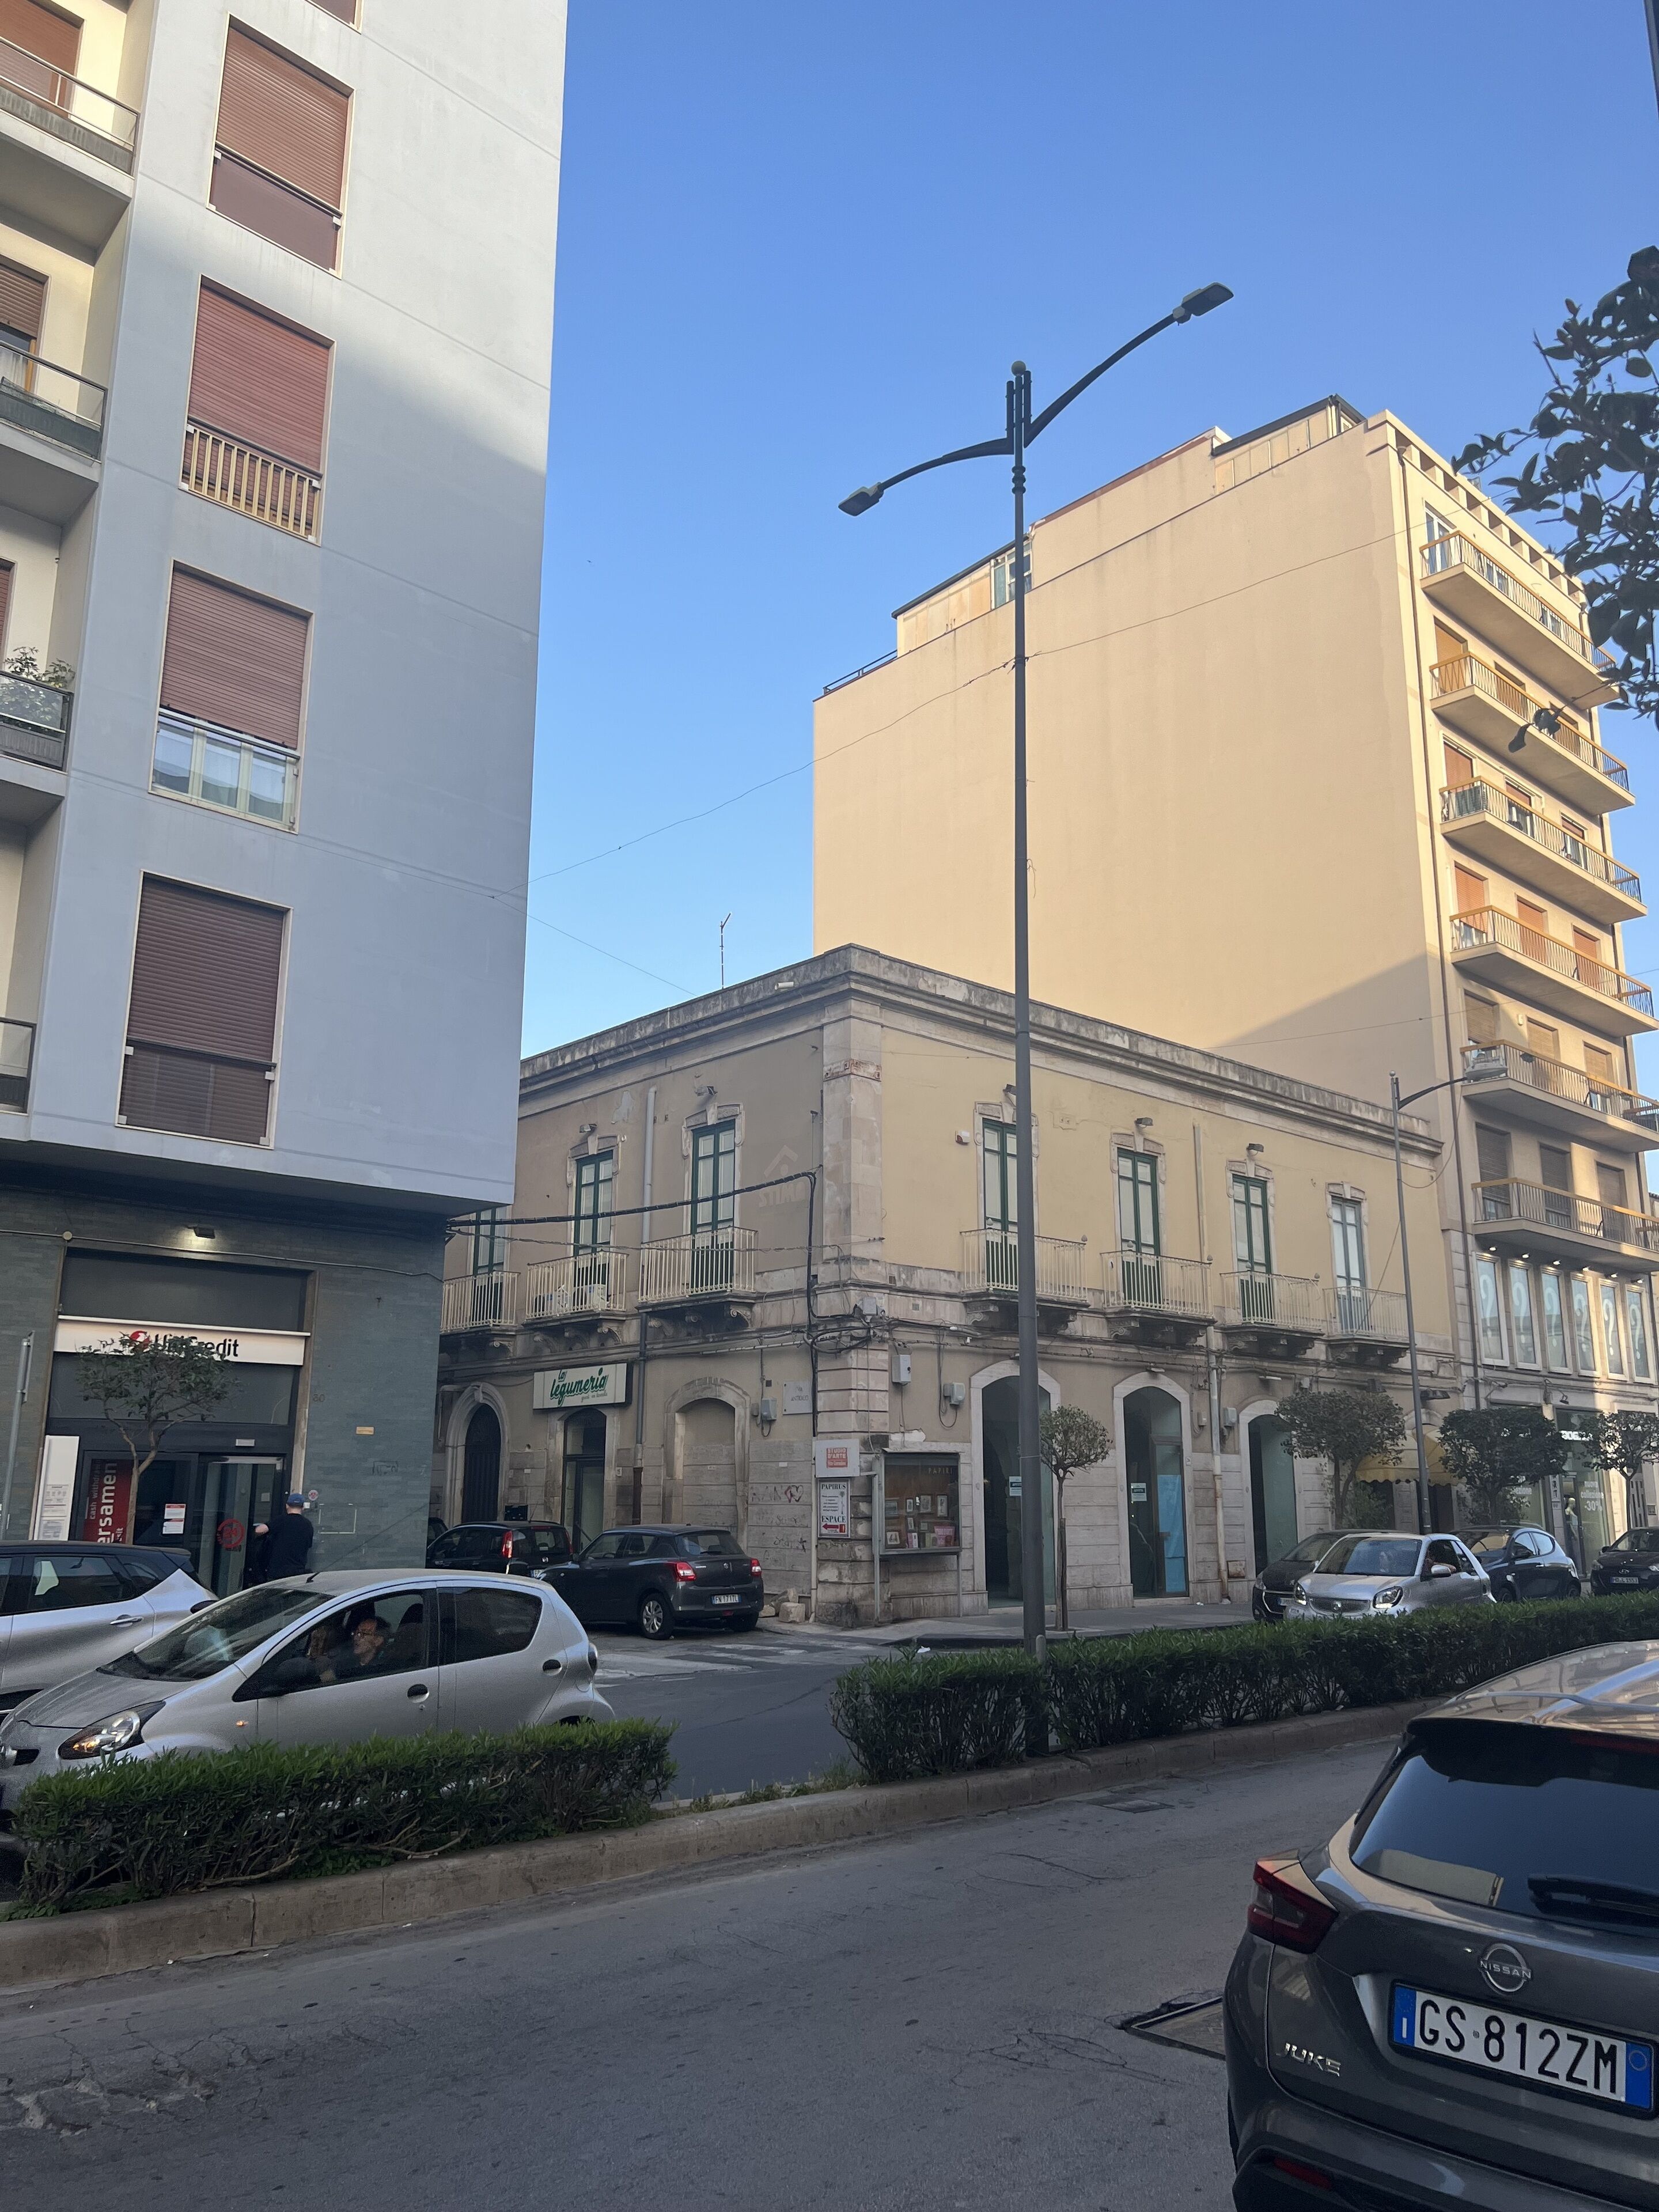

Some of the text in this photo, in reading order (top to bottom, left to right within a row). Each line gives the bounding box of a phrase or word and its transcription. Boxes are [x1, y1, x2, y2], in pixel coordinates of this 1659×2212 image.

[558, 1369, 567, 1382] la
[550, 1367, 609, 1407] legumeria
[1581, 1491, 1604, 1499] collezione
[1585, 1501, 1603, 1511] -30%
[1480, 1960, 1531, 1979] NISSAN
[1275, 2043, 1341, 2077] JUKE
